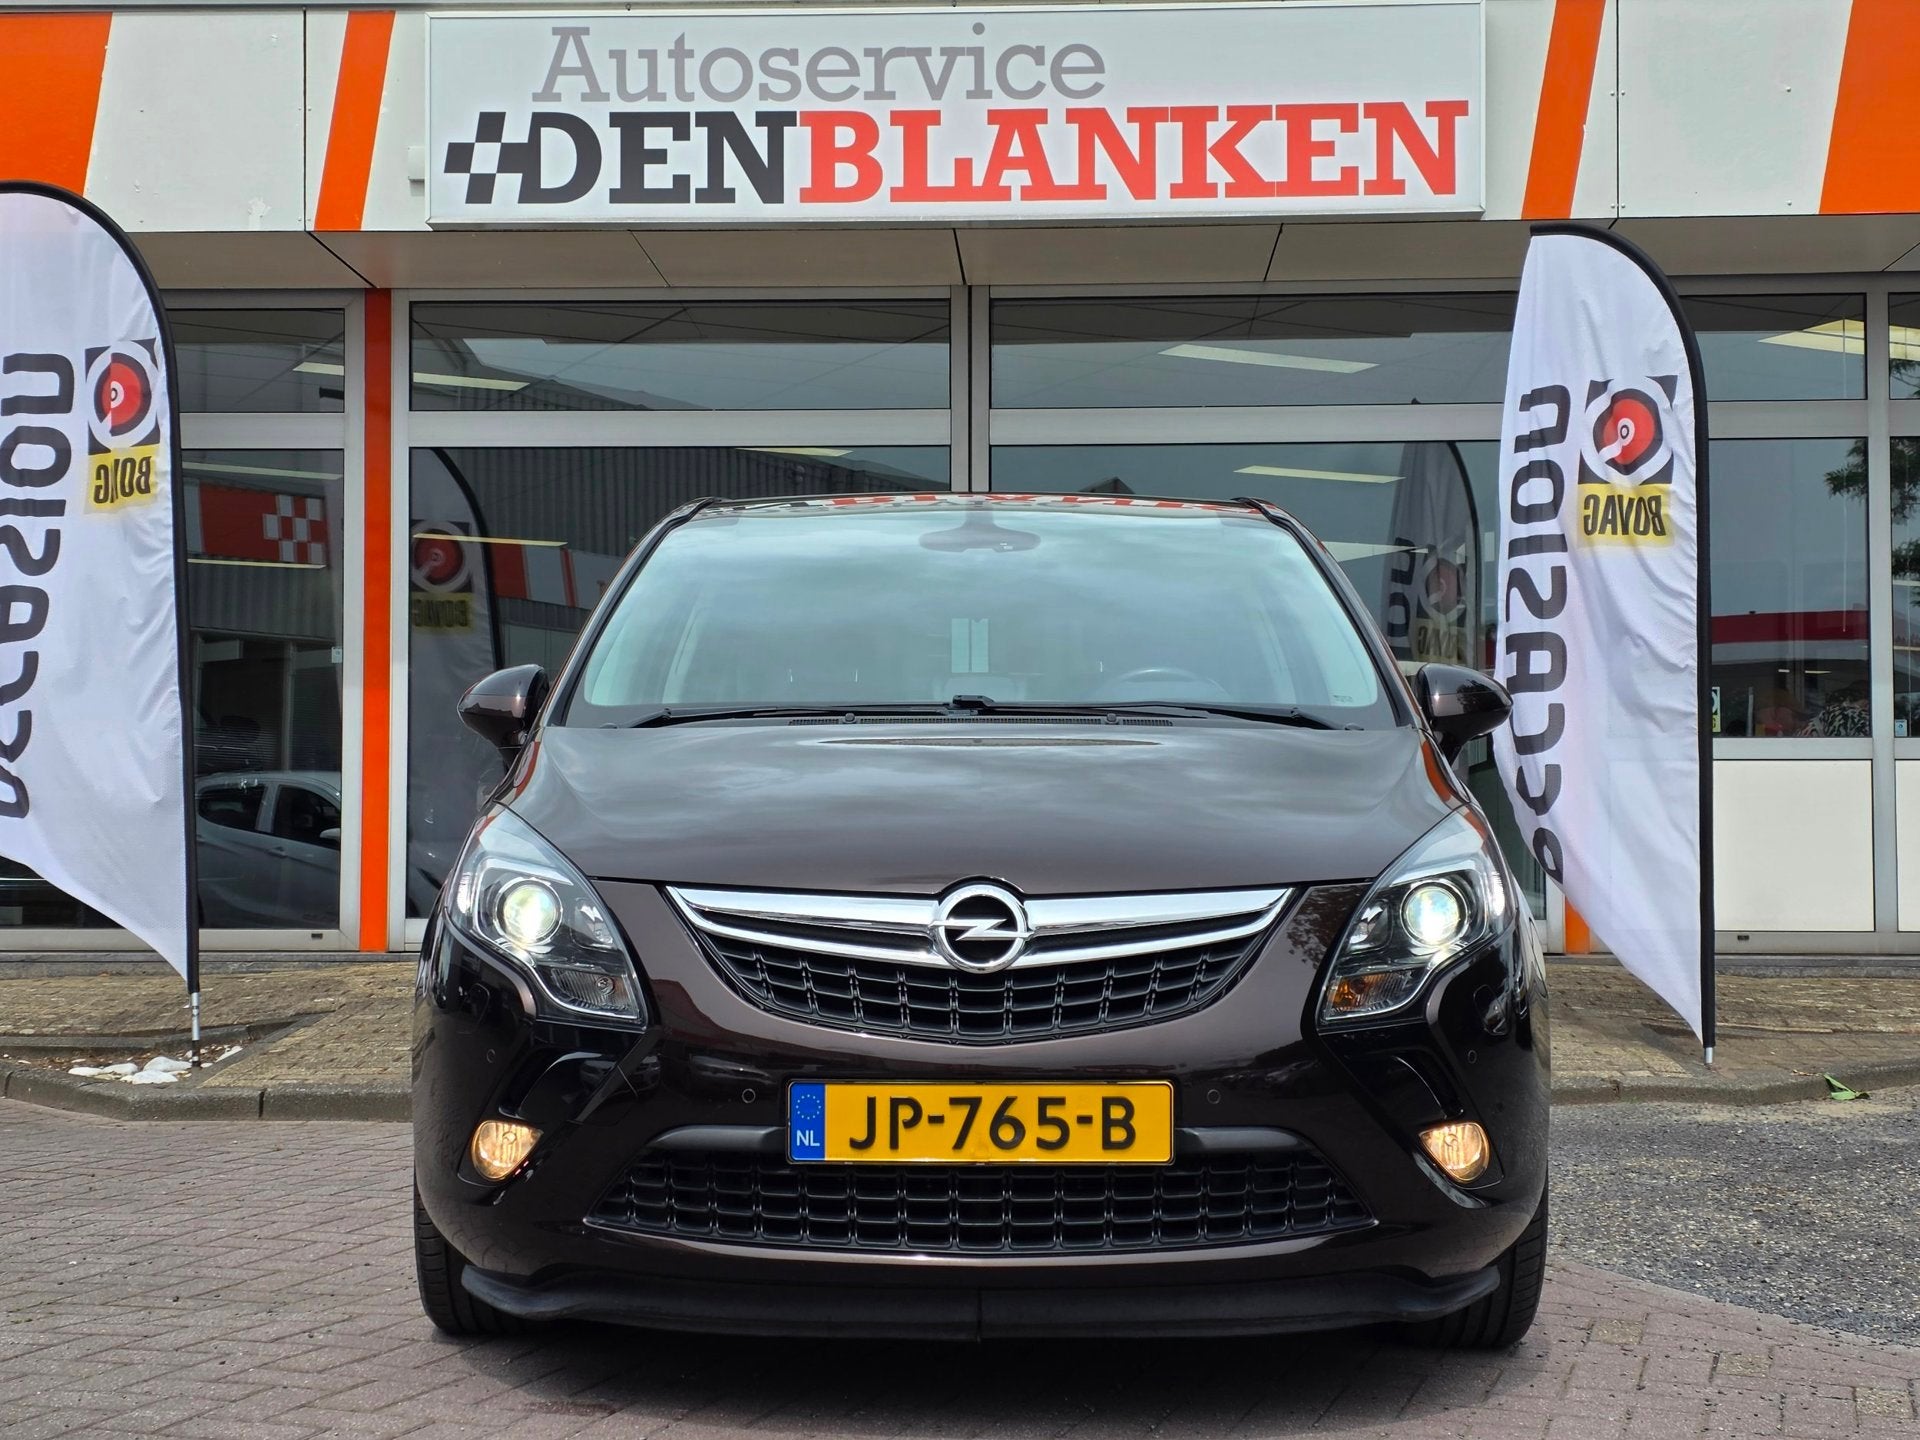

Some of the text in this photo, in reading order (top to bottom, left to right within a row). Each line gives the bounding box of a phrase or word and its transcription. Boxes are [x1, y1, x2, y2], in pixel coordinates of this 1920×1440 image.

[532, 22, 1105, 103] Autoservice
[795, 1129, 820, 1147] NL
[849, 1095, 1137, 1151] JP-765-B
